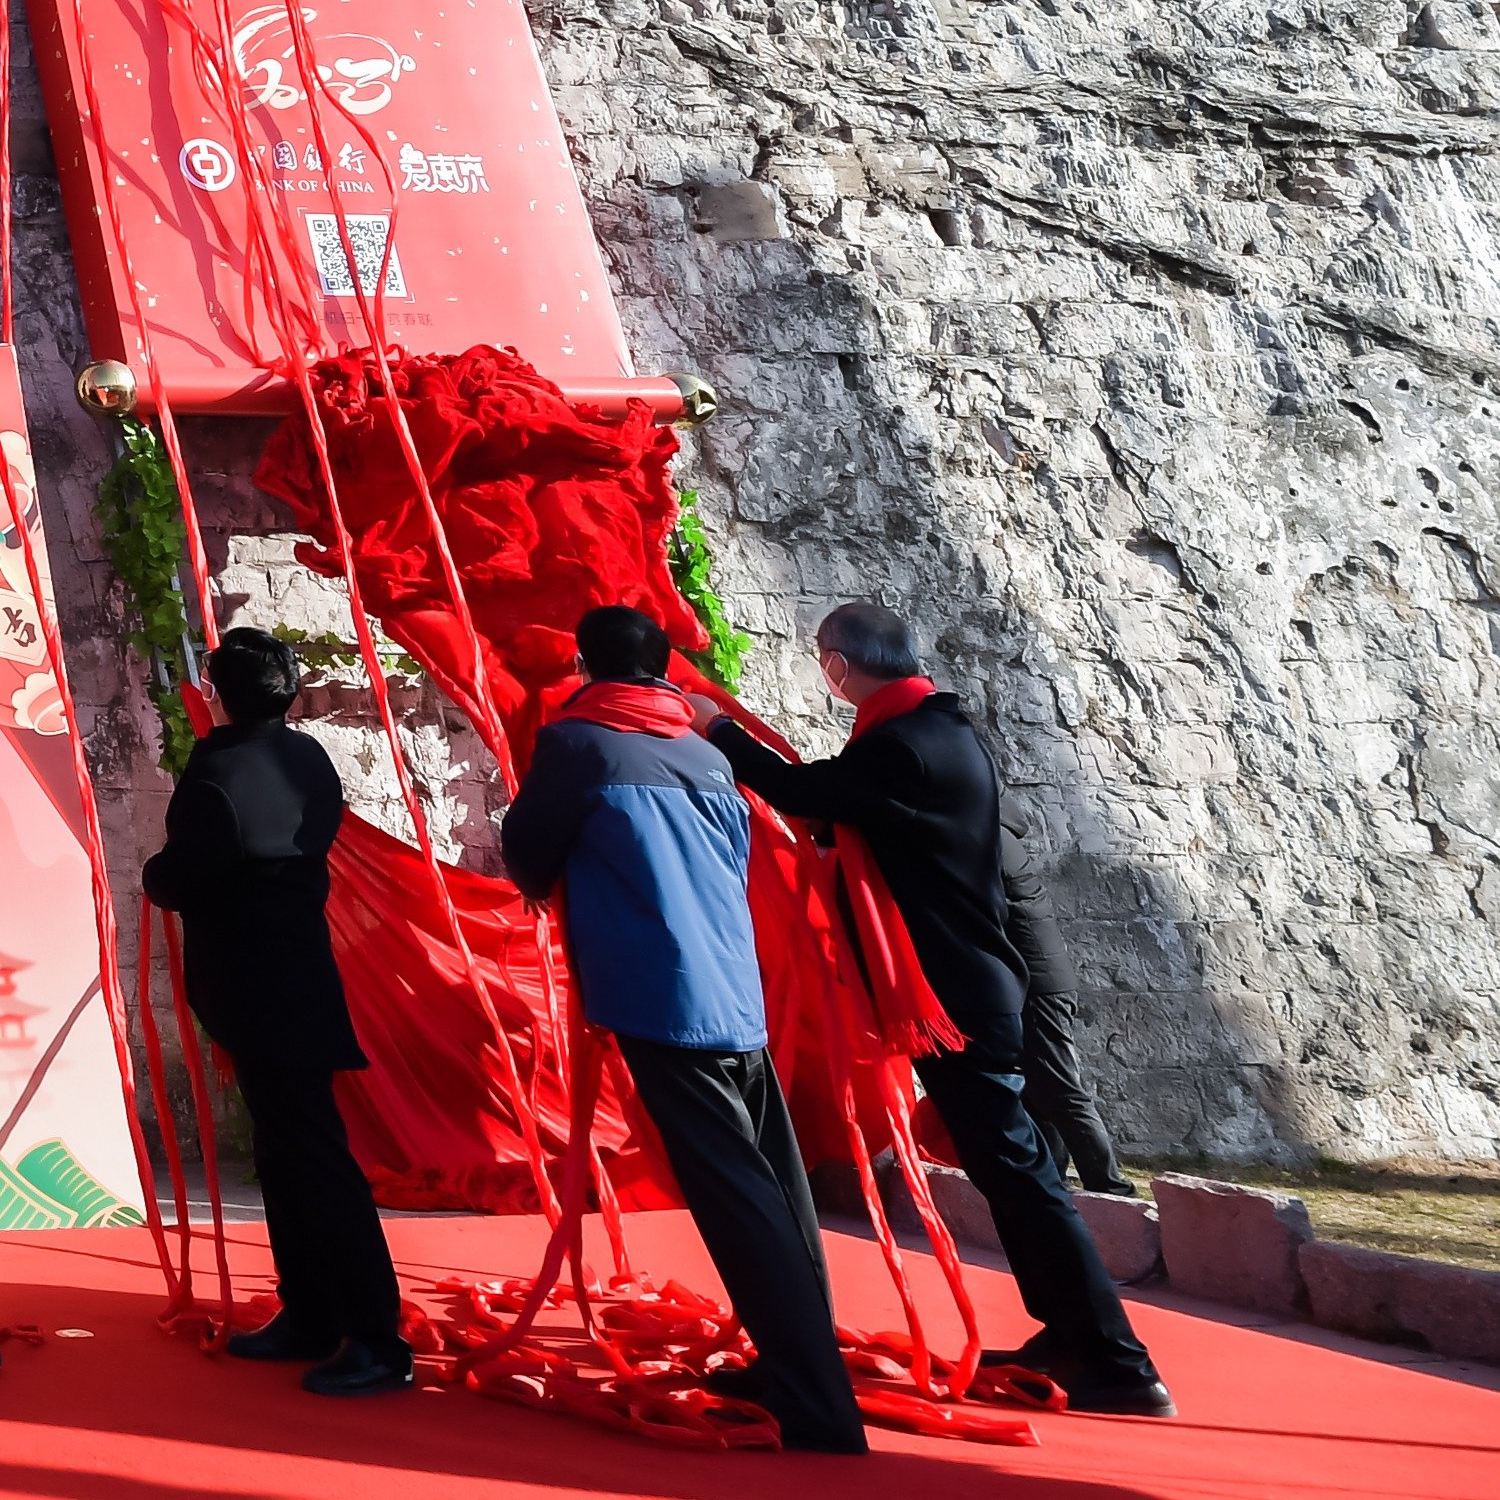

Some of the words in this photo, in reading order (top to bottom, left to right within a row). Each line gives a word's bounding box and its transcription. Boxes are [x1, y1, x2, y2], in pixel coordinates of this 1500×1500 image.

[255, 179, 295, 193] BNK
[298, 180, 318, 193] OF
[2, 606, 37, 648] 吉
